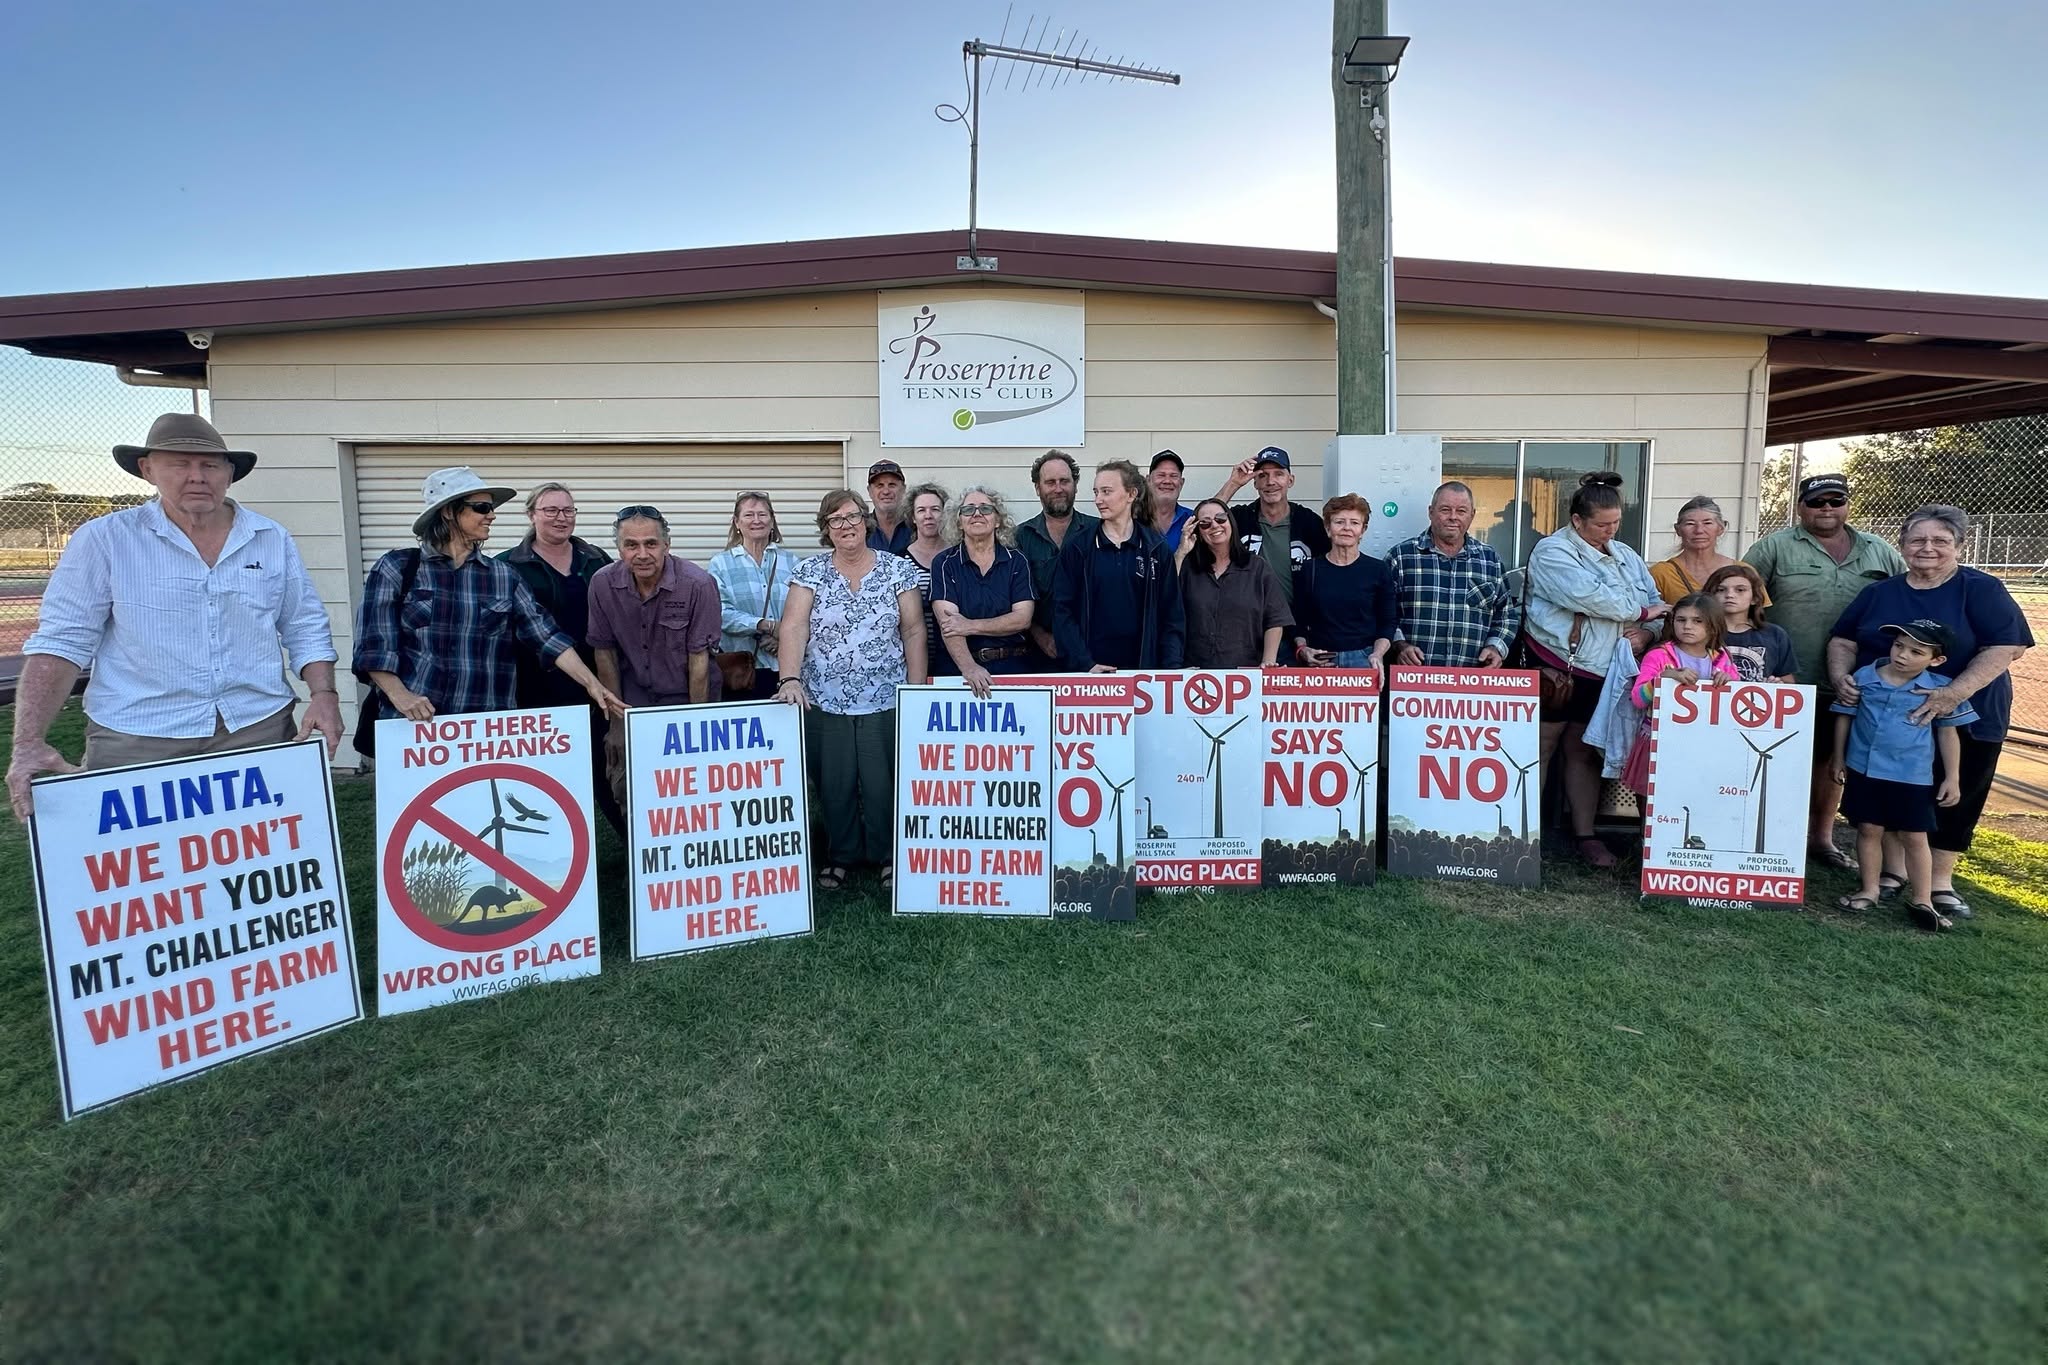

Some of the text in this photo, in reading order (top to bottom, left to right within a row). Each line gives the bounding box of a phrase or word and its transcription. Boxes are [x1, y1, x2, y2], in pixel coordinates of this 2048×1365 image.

[904, 334, 1052, 390] Proserpine
[903, 387, 1053, 400] TENNIS CLUB
[1074, 686, 1126, 696] THANKS
[1272, 676, 1302, 688] HERE,
[1306, 676, 1323, 686] NO
[1326, 676, 1372, 687] THANKS
[1397, 672, 1532, 688] NOT HERE, NO THANKS
[1134, 674, 1251, 715] STOP
[1672, 684, 1804, 730] STOP
[927, 702, 1025, 736] ALINTA,
[1392, 697, 1537, 722] COMMUNITY
[415, 714, 559, 744] NOT HERE,
[663, 716, 774, 756] ALINTA,
[1056, 713, 1132, 736] UNITY
[1426, 724, 1500, 752] SAYS
[403, 734, 570, 768] NO THANKS
[1271, 728, 1343, 754] SAYS
[918, 744, 1034, 772] WE DON'T
[1055, 742, 1095, 770] YS
[654, 758, 784, 798] WE DON'T
[1264, 761, 1348, 807] NO
[1419, 755, 1508, 802] NO
[1719, 786, 1748, 796] 240 m
[98, 766, 284, 834] ALINTA,
[912, 780, 1041, 807] WANT YOUR
[648, 795, 794, 838] WANT YOUR
[904, 815, 1046, 841] MT. CHALLENGER
[1657, 815, 1668, 824] 64
[84, 814, 304, 893] WE DON'T
[642, 830, 802, 874] MT. CHALLENGER
[908, 848, 1042, 876] WIND FARM
[1667, 852, 1714, 860] PROSERPINE
[1689, 860, 1712, 868] STACK
[1747, 857, 1788, 865] PROPOSED
[1198, 863, 1256, 880] PLACE
[1279, 872, 1336, 883] WWFAG.ORG
[1436, 865, 1498, 878] WWFAG.ORG
[1648, 872, 1800, 899] WRONG PLACE
[76, 858, 323, 947] WANT YOUR
[648, 865, 800, 912] WIND FARM
[939, 881, 1010, 906] HERE.
[1688, 898, 1752, 910] WWFAG.ORG
[687, 904, 767, 940] HERE.
[70, 900, 338, 999] MT. CHALLENGER
[384, 936, 596, 994] WRONG PLACE
[84, 940, 338, 1046] WIND FARM
[452, 973, 540, 1000] WWFAG.ORG
[158, 1001, 291, 1070] HERE.
